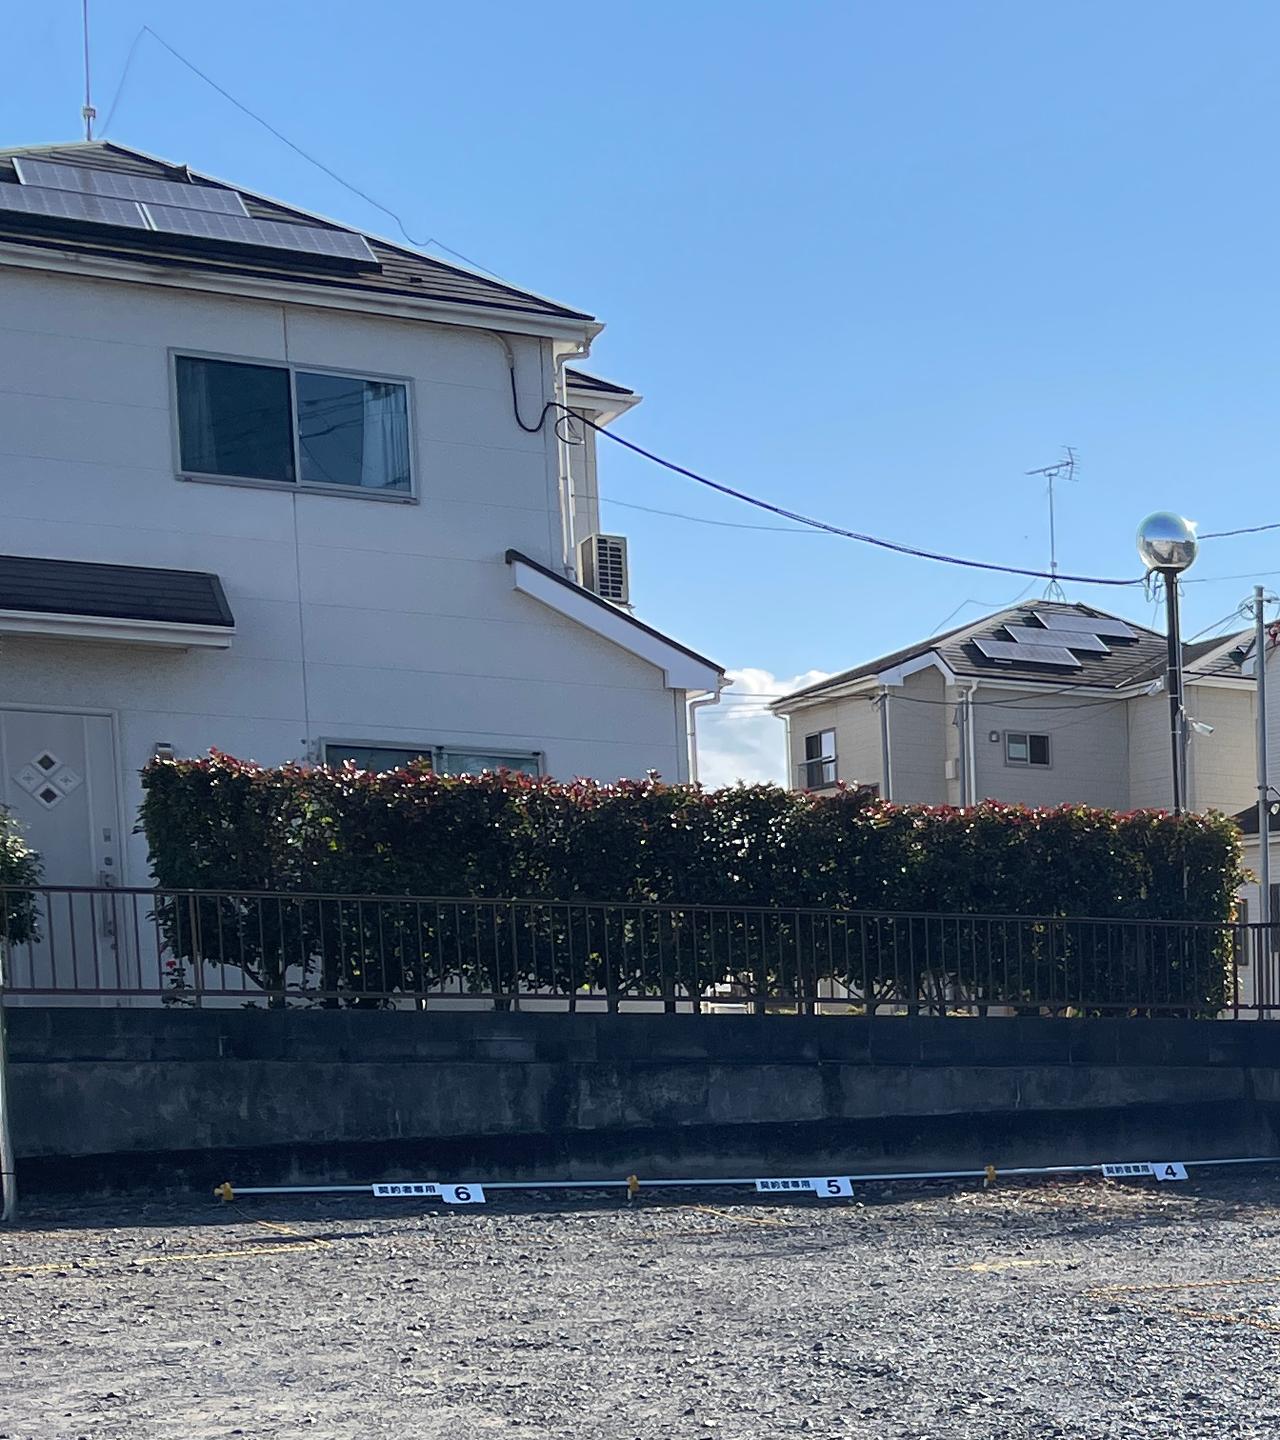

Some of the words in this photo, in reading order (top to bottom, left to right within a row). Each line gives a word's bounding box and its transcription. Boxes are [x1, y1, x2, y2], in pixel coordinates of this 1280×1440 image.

[1165, 1164, 1177, 1178] 4
[378, 1185, 436, 1195] 契約者専用
[454, 1186, 471, 1201] 6
[827, 1179, 842, 1195] 5
